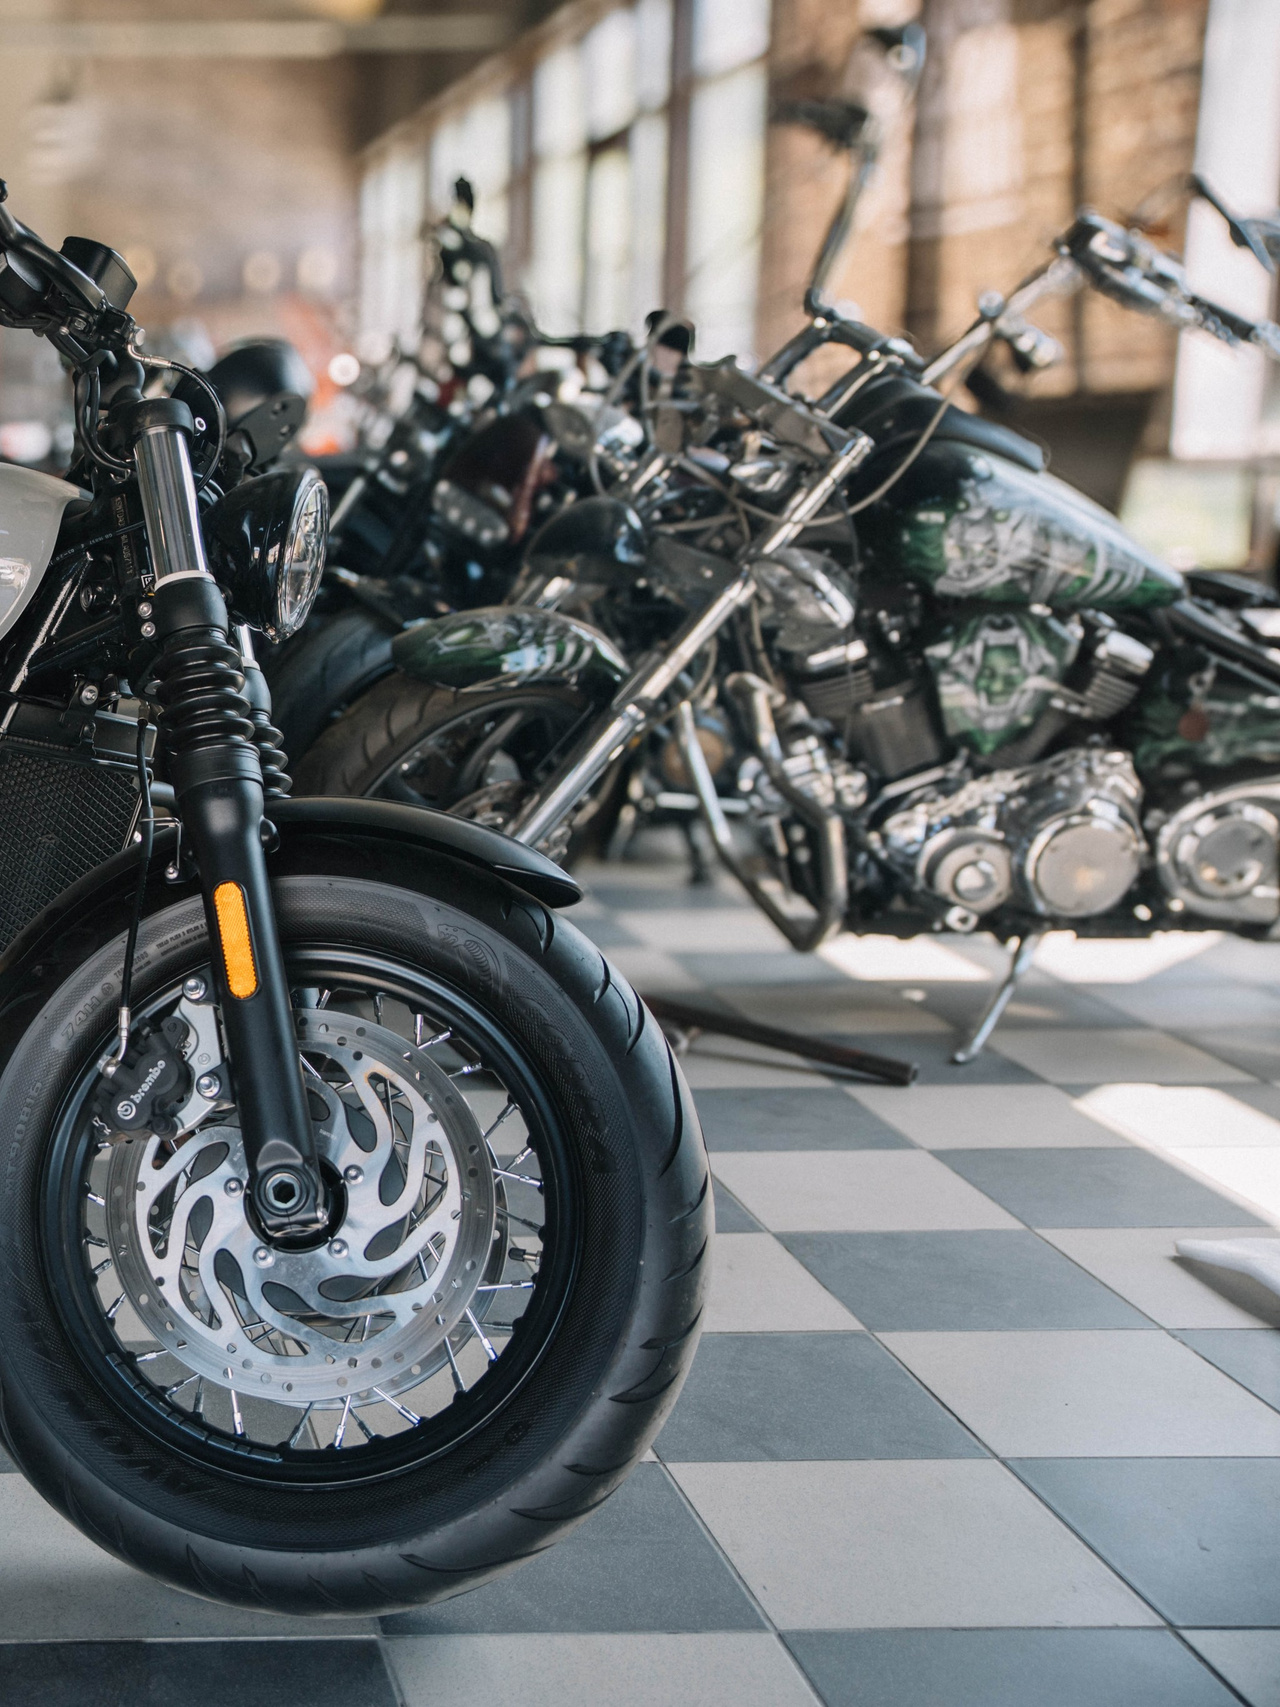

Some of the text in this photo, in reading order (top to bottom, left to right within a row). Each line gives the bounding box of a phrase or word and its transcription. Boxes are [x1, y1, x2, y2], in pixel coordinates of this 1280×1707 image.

[60, 995, 101, 1041] 74H
[133, 1060, 166, 1104] brembo
[4, 1081, 43, 1195] MT90B16
